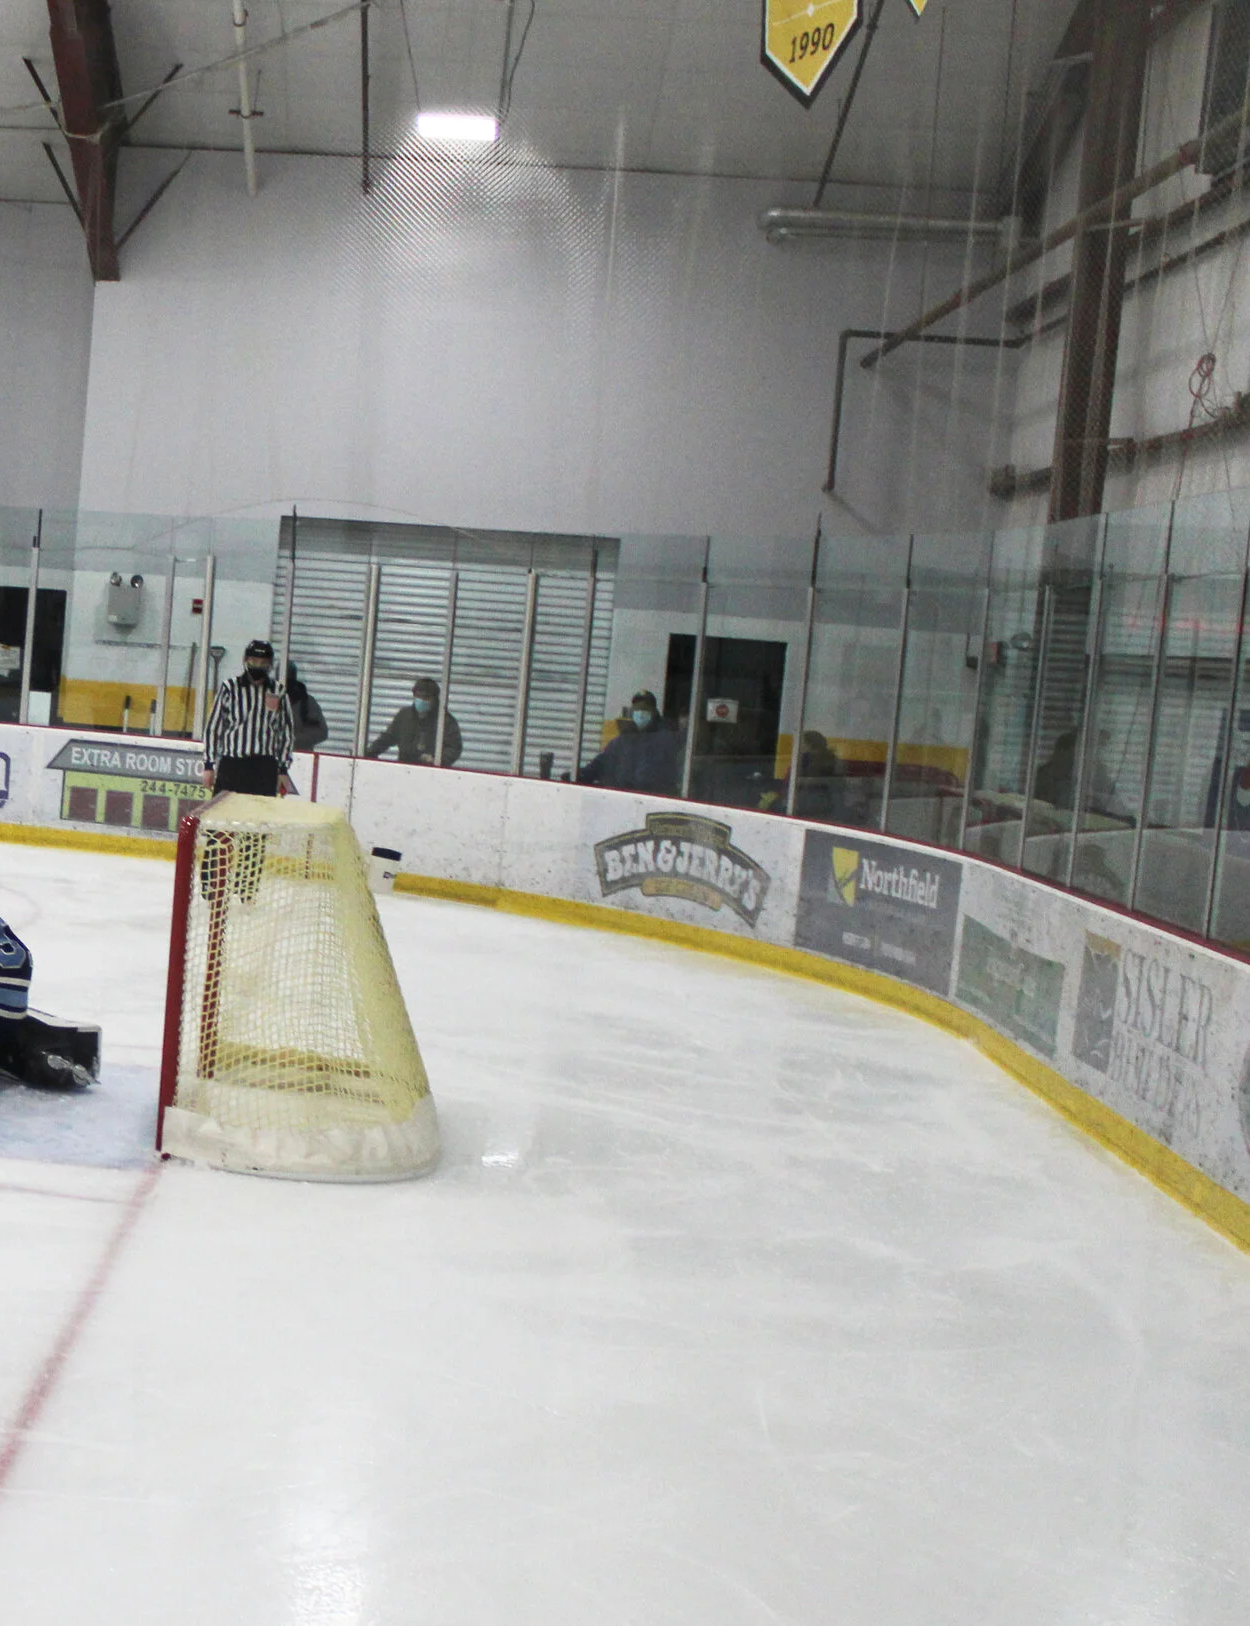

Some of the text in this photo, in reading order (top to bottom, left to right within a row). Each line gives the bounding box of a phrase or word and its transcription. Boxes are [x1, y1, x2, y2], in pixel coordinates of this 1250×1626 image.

[788, 22, 835, 64] 1990
[71, 747, 205, 777] EXTRA ROOM STO
[140, 780, 207, 799] 244-7475
[859, 857, 940, 909] Northfield
